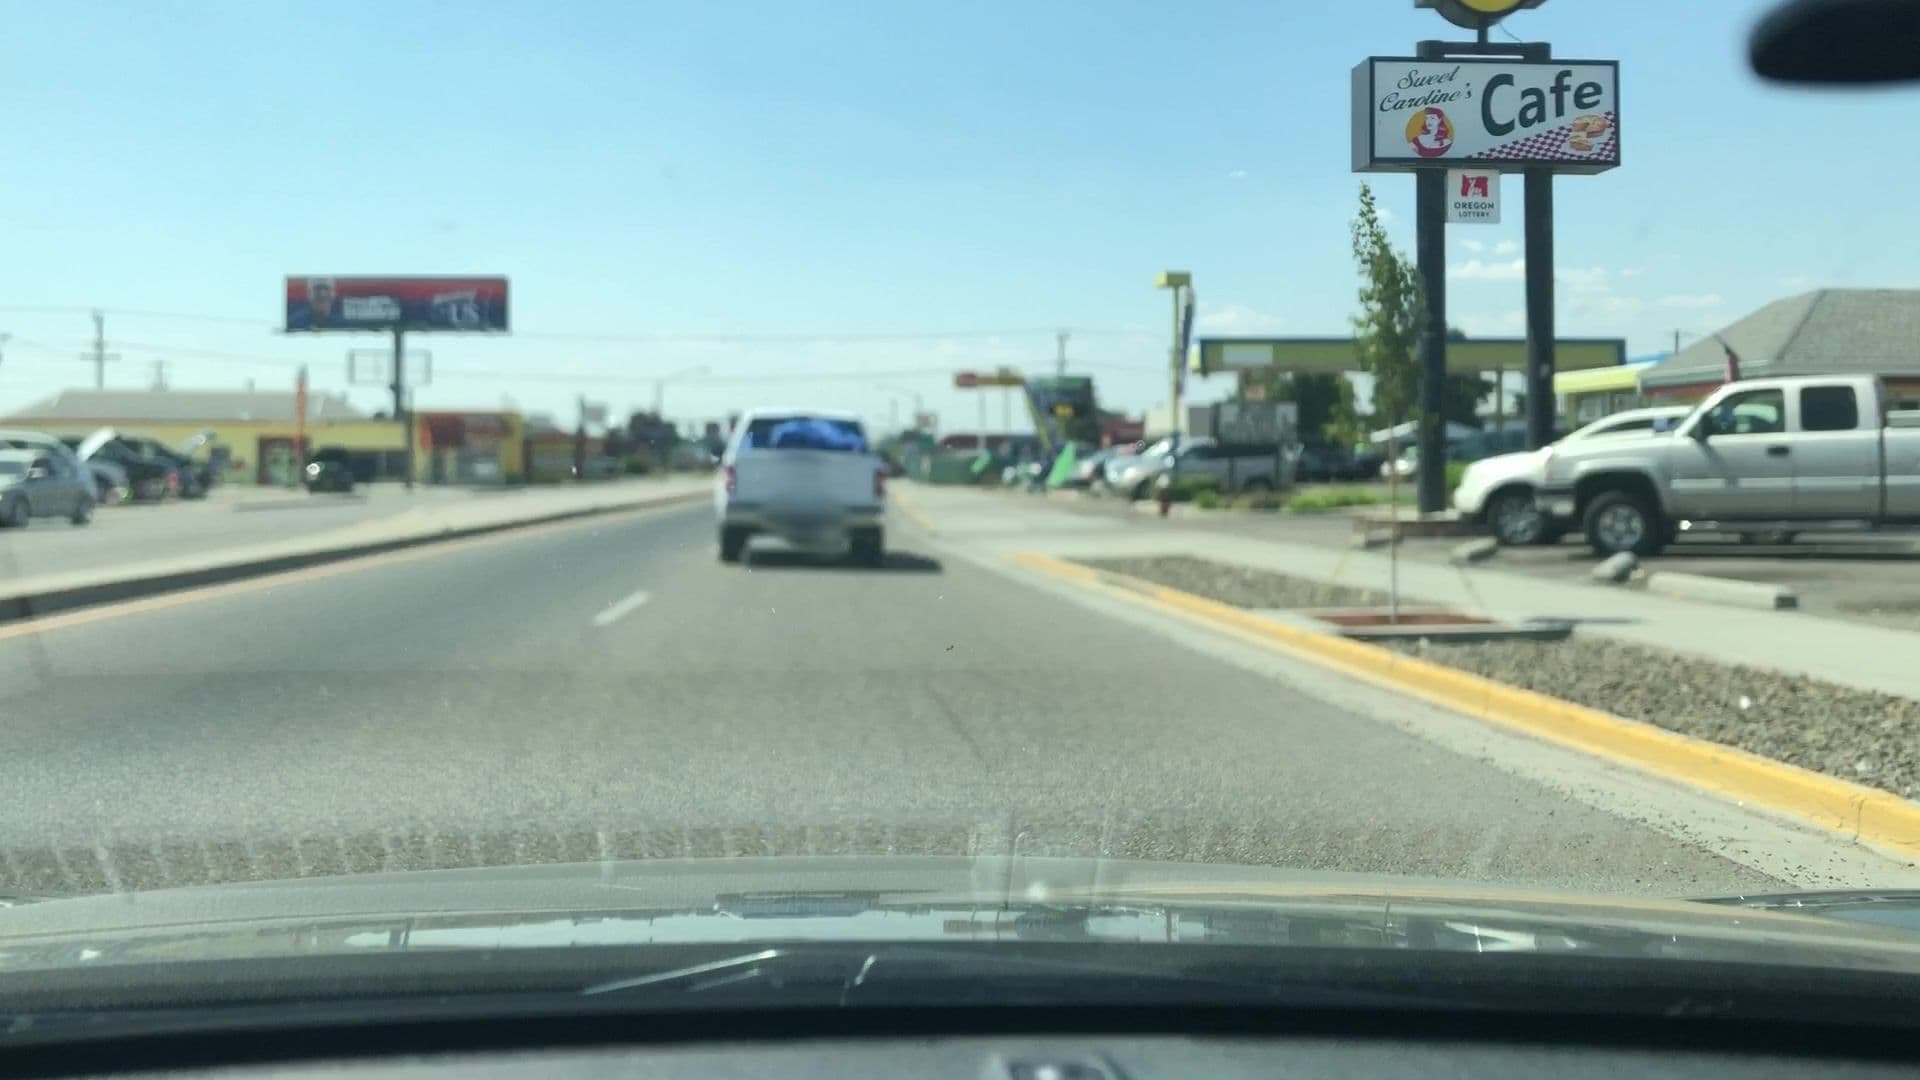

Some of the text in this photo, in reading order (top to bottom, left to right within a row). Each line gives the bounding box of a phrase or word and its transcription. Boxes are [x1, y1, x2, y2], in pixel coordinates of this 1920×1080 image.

[1397, 65, 1460, 89] Sweet
[1379, 82, 1472, 112] Caroline's
[1481, 69, 1603, 137] Cafe
[1453, 201, 1495, 210] OREGON
